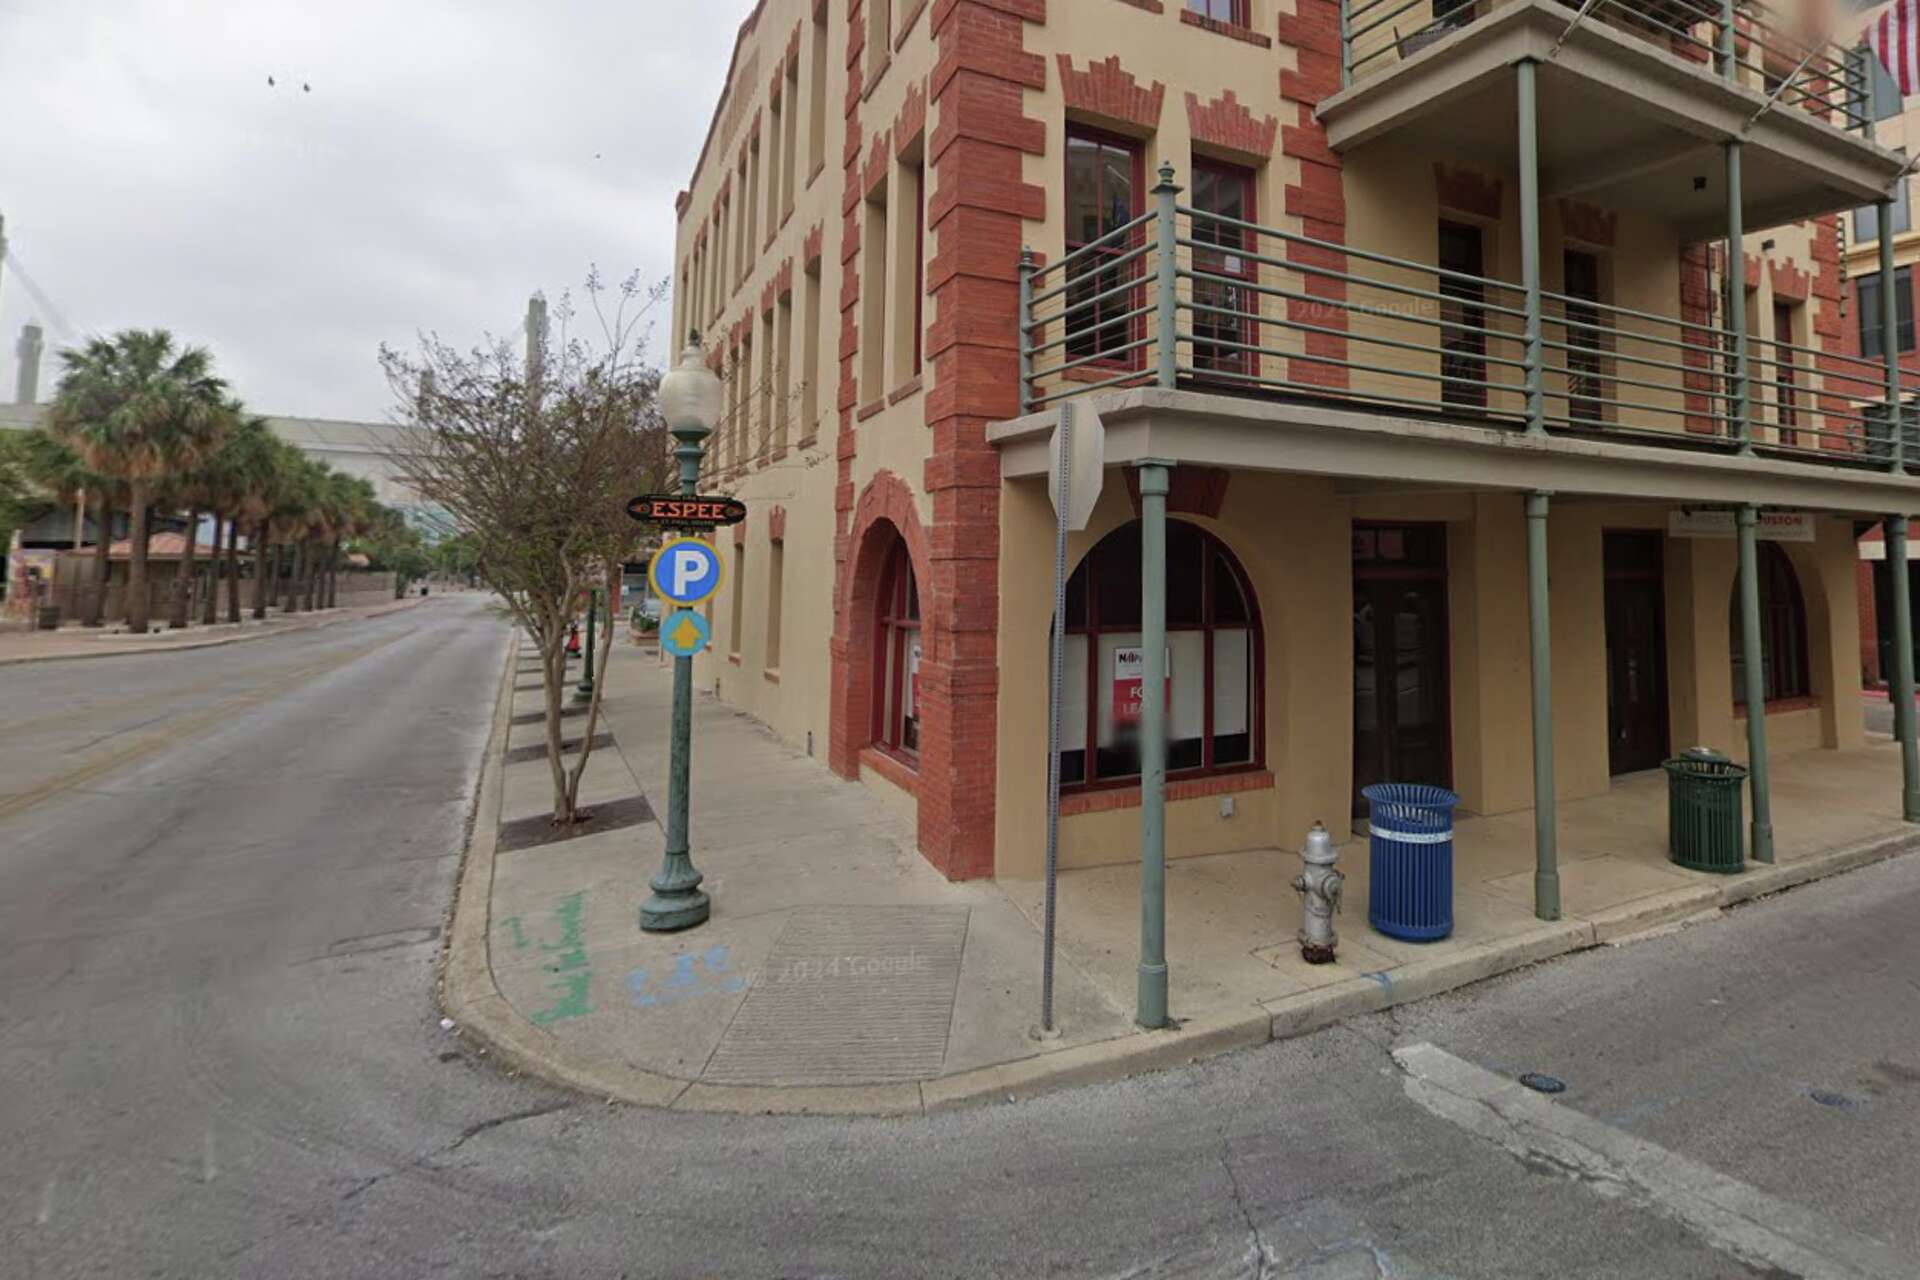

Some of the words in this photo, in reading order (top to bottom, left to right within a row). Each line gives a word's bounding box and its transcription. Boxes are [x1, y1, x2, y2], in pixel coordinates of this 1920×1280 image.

[652, 501, 725, 518] ESPEE
[673, 550, 710, 596] P
[1131, 687, 1143, 698] FO
